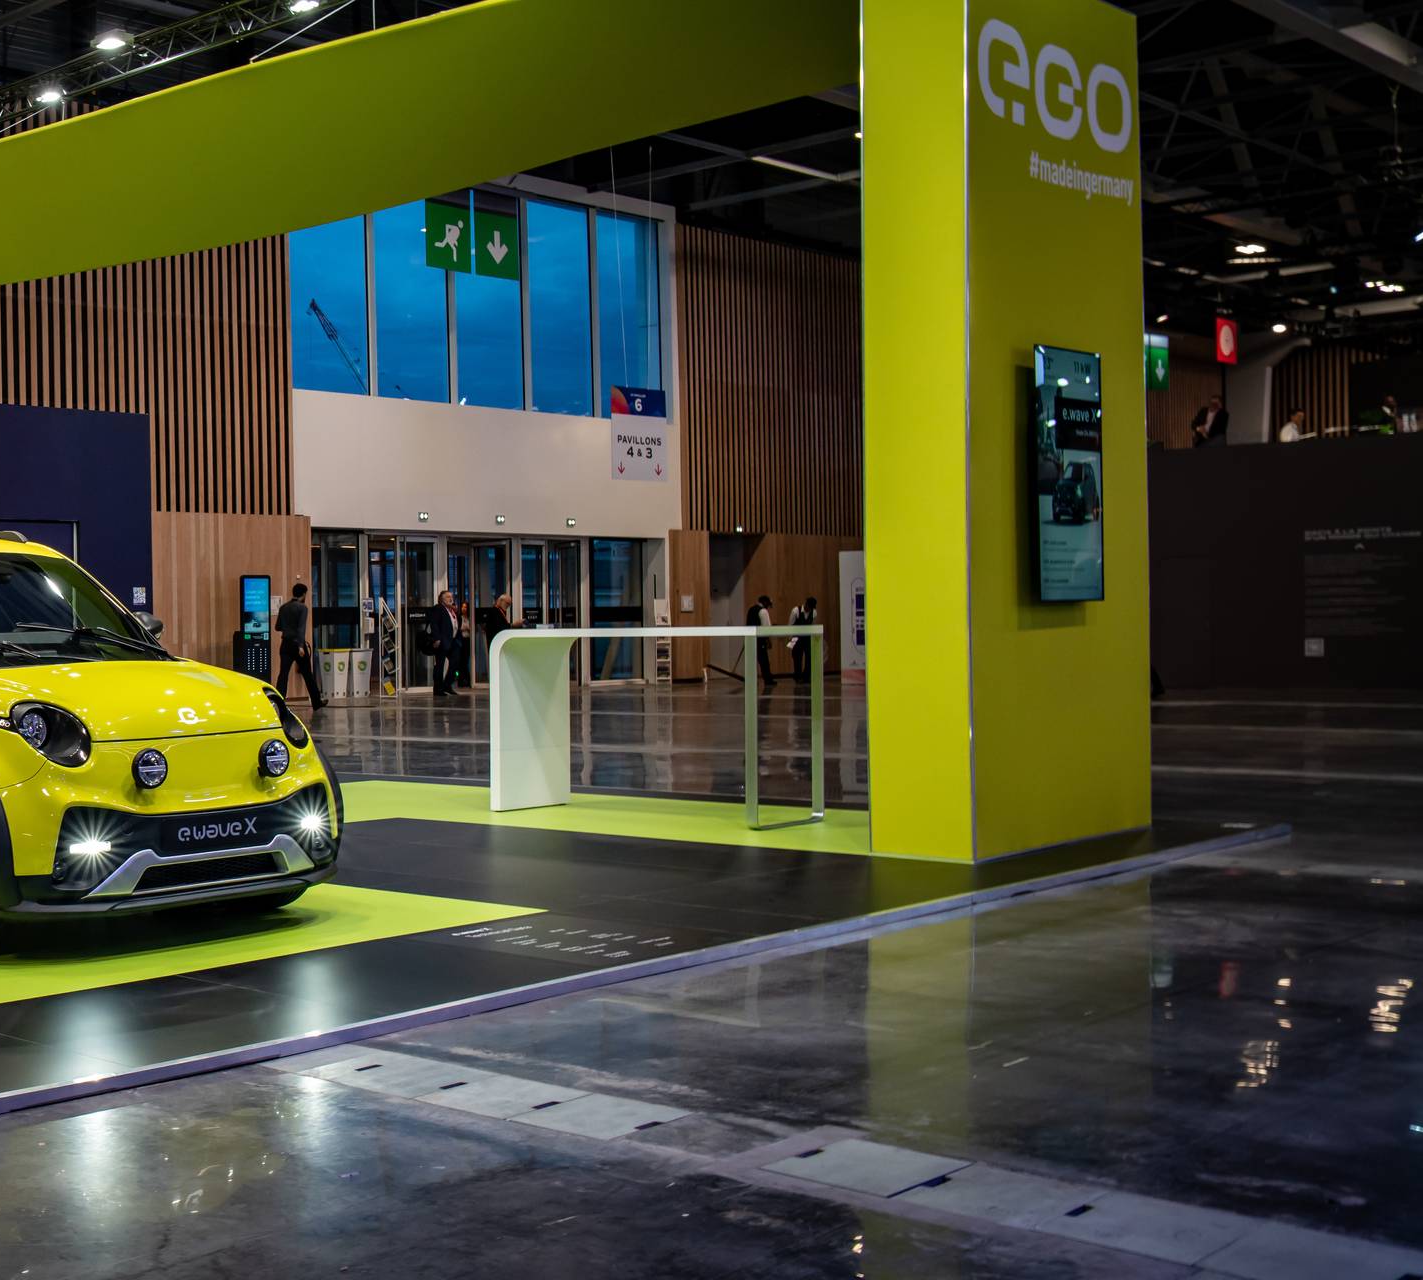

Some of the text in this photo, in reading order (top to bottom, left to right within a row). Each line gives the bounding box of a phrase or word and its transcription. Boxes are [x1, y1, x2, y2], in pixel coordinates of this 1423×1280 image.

[1029, 151, 1134, 206] #madeingermany
[634, 398, 643, 412] 6
[617, 434, 662, 446] PAVILLONS
[626, 446, 653, 459] 4 & 3
[244, 816, 258, 835] X
